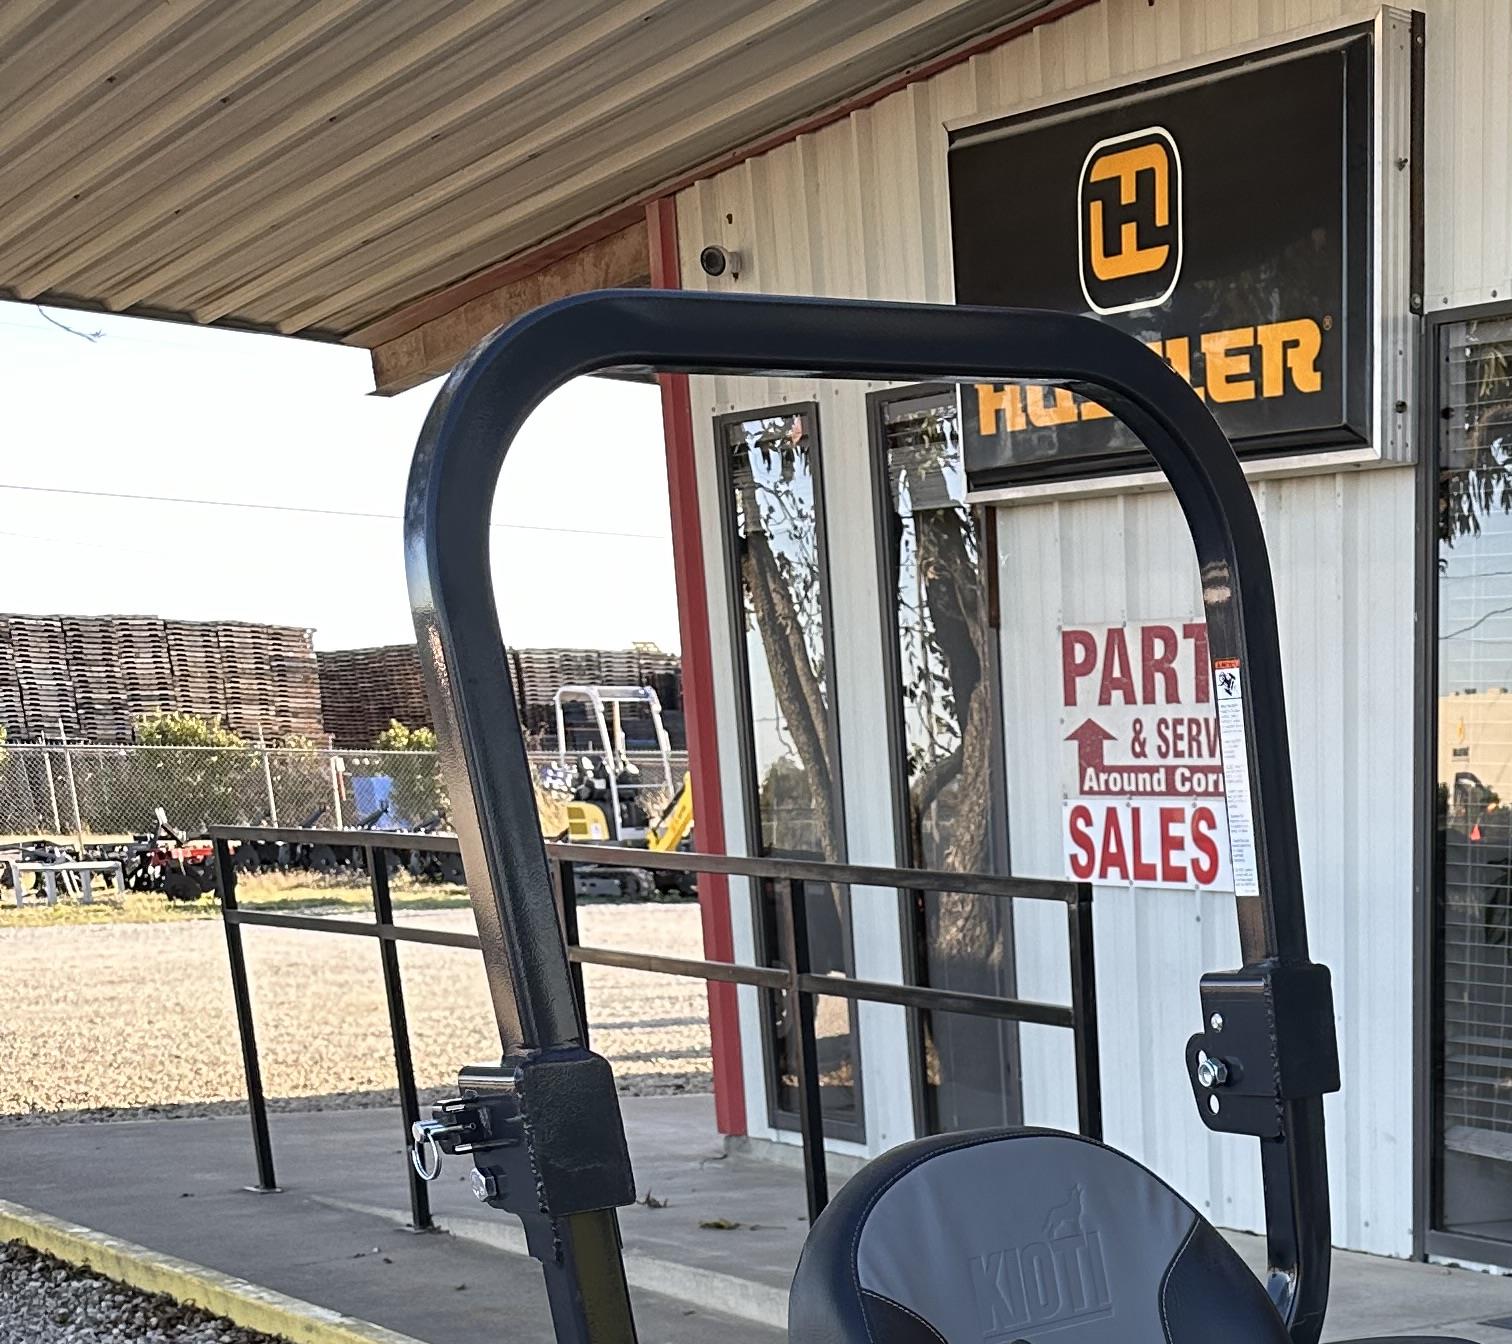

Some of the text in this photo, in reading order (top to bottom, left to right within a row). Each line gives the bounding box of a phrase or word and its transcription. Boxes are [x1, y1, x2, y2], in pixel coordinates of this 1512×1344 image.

[1062, 623, 1210, 706] PART
[1131, 717, 1220, 759] & SERV
[1083, 767, 1224, 793] Around Cor
[1069, 805, 1219, 885] SALES
[968, 1230, 1112, 1335] KIOTI
